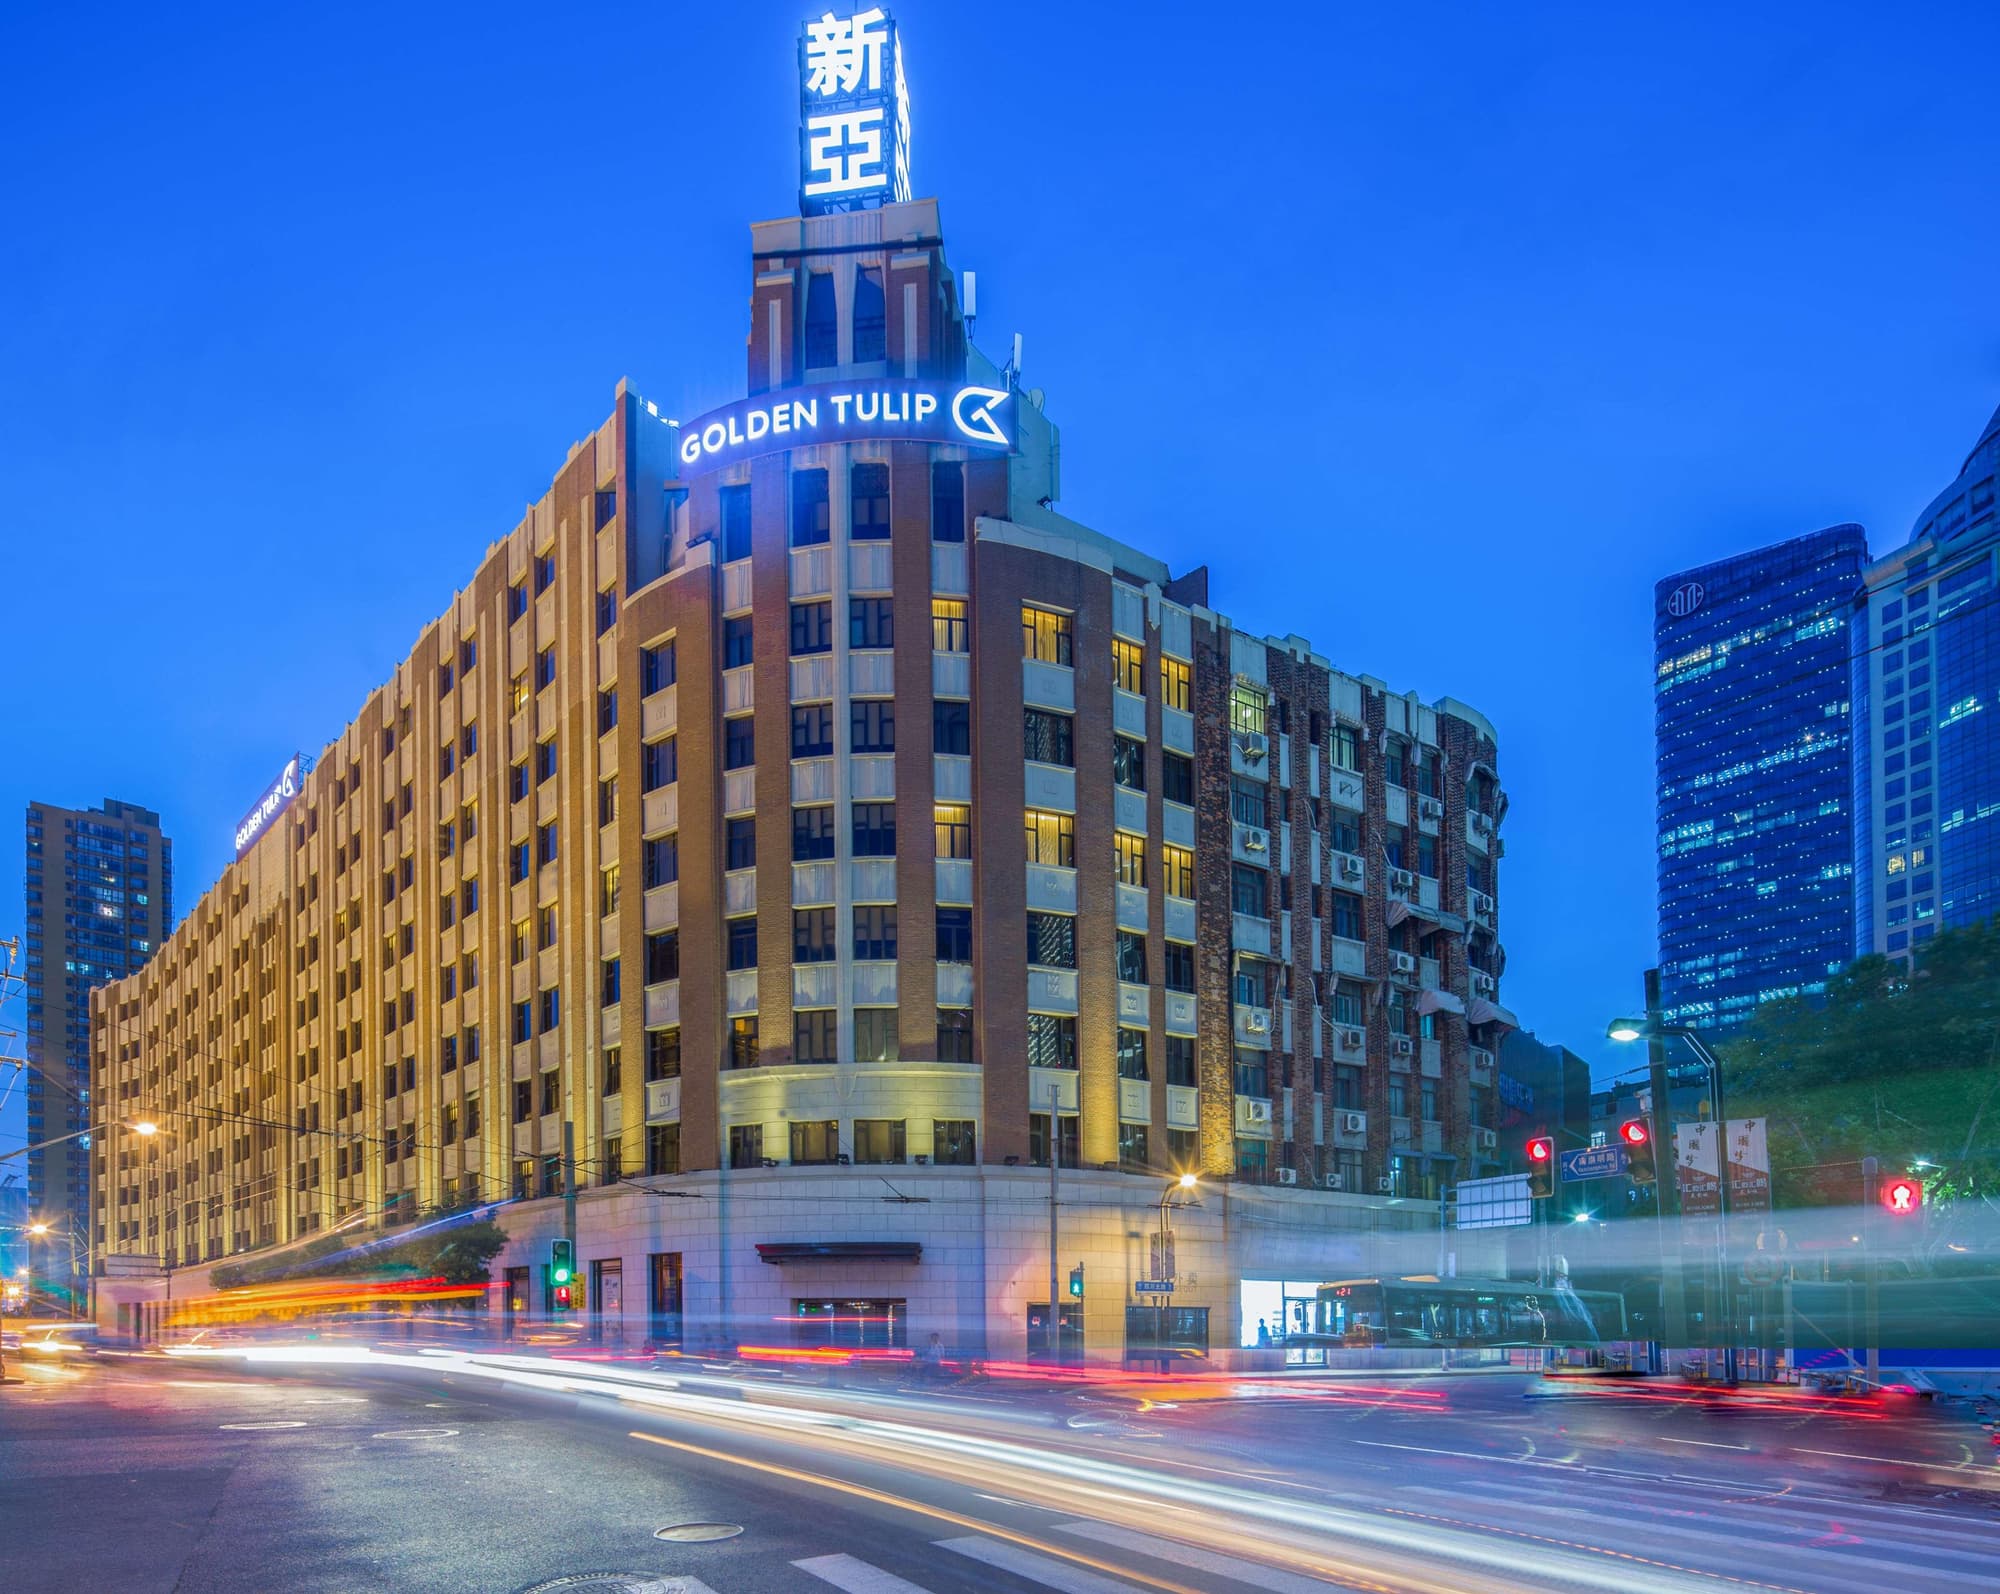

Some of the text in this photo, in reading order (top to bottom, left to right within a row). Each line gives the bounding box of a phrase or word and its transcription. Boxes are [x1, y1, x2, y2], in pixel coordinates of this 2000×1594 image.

[805, 8, 888, 197] 新亞
[681, 392, 937, 464] GOLDEN TULIP
